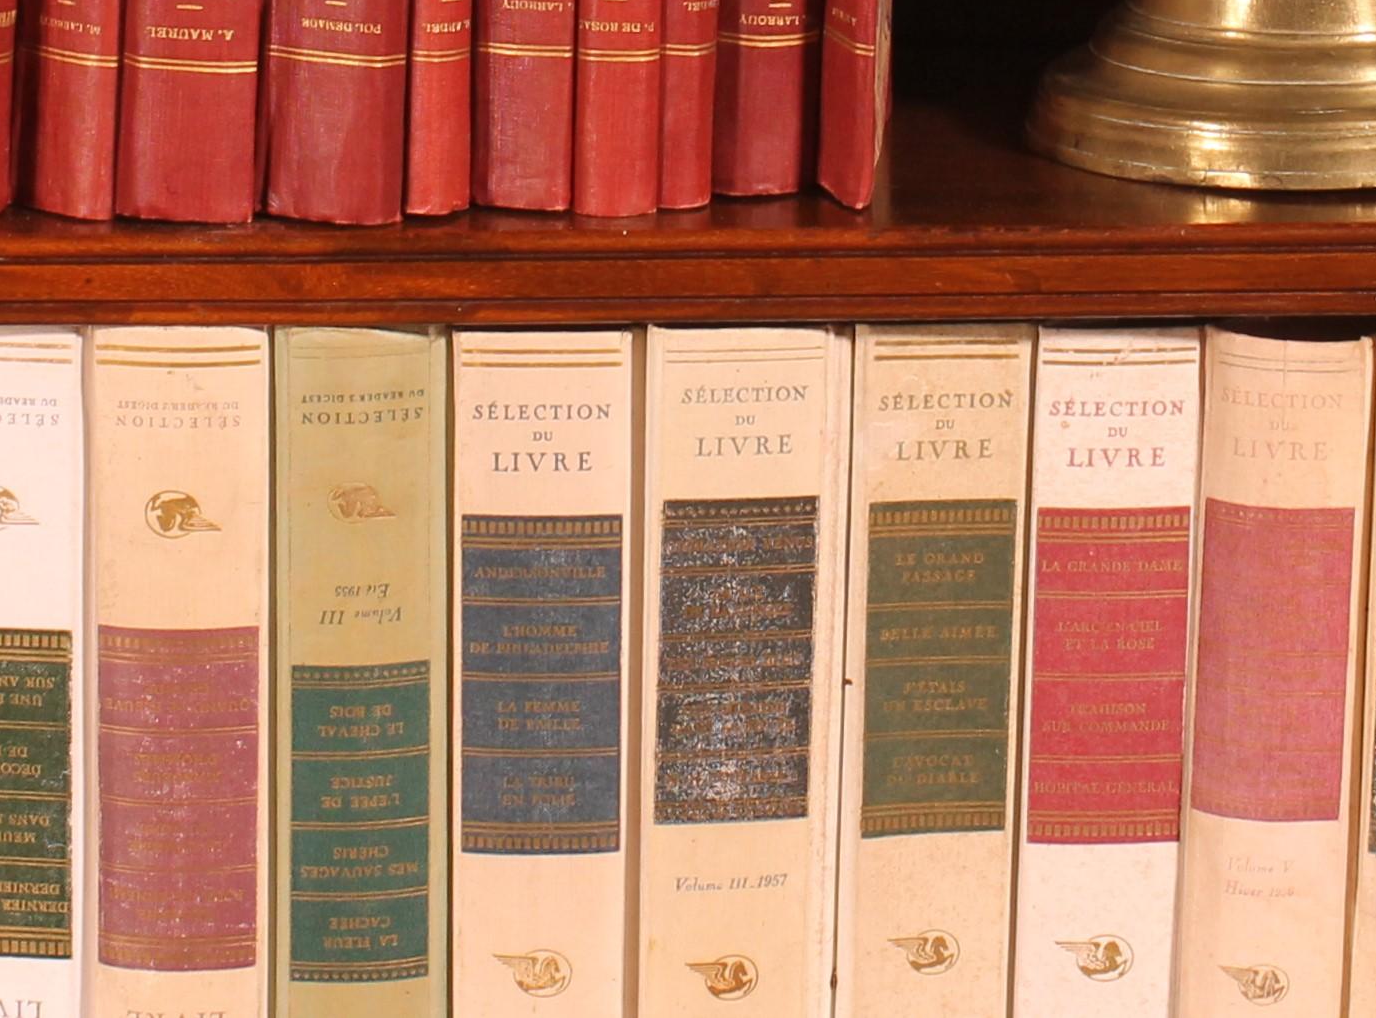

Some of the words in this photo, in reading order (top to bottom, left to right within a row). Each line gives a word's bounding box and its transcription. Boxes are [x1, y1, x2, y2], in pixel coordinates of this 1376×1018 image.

[145, 27, 215, 41] MAUREL
[354, 22, 382, 34] POL
[622, 23, 642, 33] DE
[217, 30, 235, 41] A.
[300, 393, 345, 404] DIGEST
[348, 392, 404, 403] READER'S
[407, 388, 425, 399] DU
[680, 384, 808, 406] SÉLECTION
[1222, 385, 1343, 411] SÉLECTION
[41, 397, 58, 407] DU
[875, 390, 1016, 413] SÉLECTION
[1048, 396, 1184, 419] SÉLECTION
[300, 405, 424, 425] SÉLECTION
[471, 396, 612, 422] SÉLECTION
[114, 414, 241, 432] SÉLECTION
[733, 415, 756, 427] DU
[934, 418, 955, 432] DU
[532, 429, 554, 443] DU
[1106, 425, 1128, 439] DU
[694, 433, 795, 458] LIVRE
[894, 437, 994, 462] LIVRE
[1231, 435, 1328, 462] LIVRE
[490, 450, 593, 473] LIVRE
[1066, 444, 1167, 469] LIVRE
[924, 551, 984, 566] GRAND
[1041, 560, 1063, 573] LA
[1067, 560, 1131, 573] GRANDE
[1138, 559, 1183, 572] DAME
[334, 584, 361, 598] 1955
[319, 609, 345, 625] III
[354, 606, 404, 624] Volume
[469, 642, 490, 655] DE
[24, 677, 56, 689] SUR
[9, 693, 43, 707] UNE
[496, 700, 518, 714] LA
[328, 705, 367, 719] BOIS
[371, 704, 393, 718] DE
[386, 721, 404, 734] LE
[497, 717, 520, 731] DE
[317, 724, 380, 739] CHEVAL
[8, 745, 29, 759] DE
[329, 774, 393, 790] JUSTICE
[320, 795, 342, 809] DE
[8, 813, 51, 827] DANS
[300, 865, 383, 880] SAUVAGES
[388, 862, 419, 877] MES
[673, 877, 723, 893] Volume
[0, 898, 69, 914] DERNIER
[322, 935, 372, 951] FLEUR
[378, 933, 399, 947] LA
